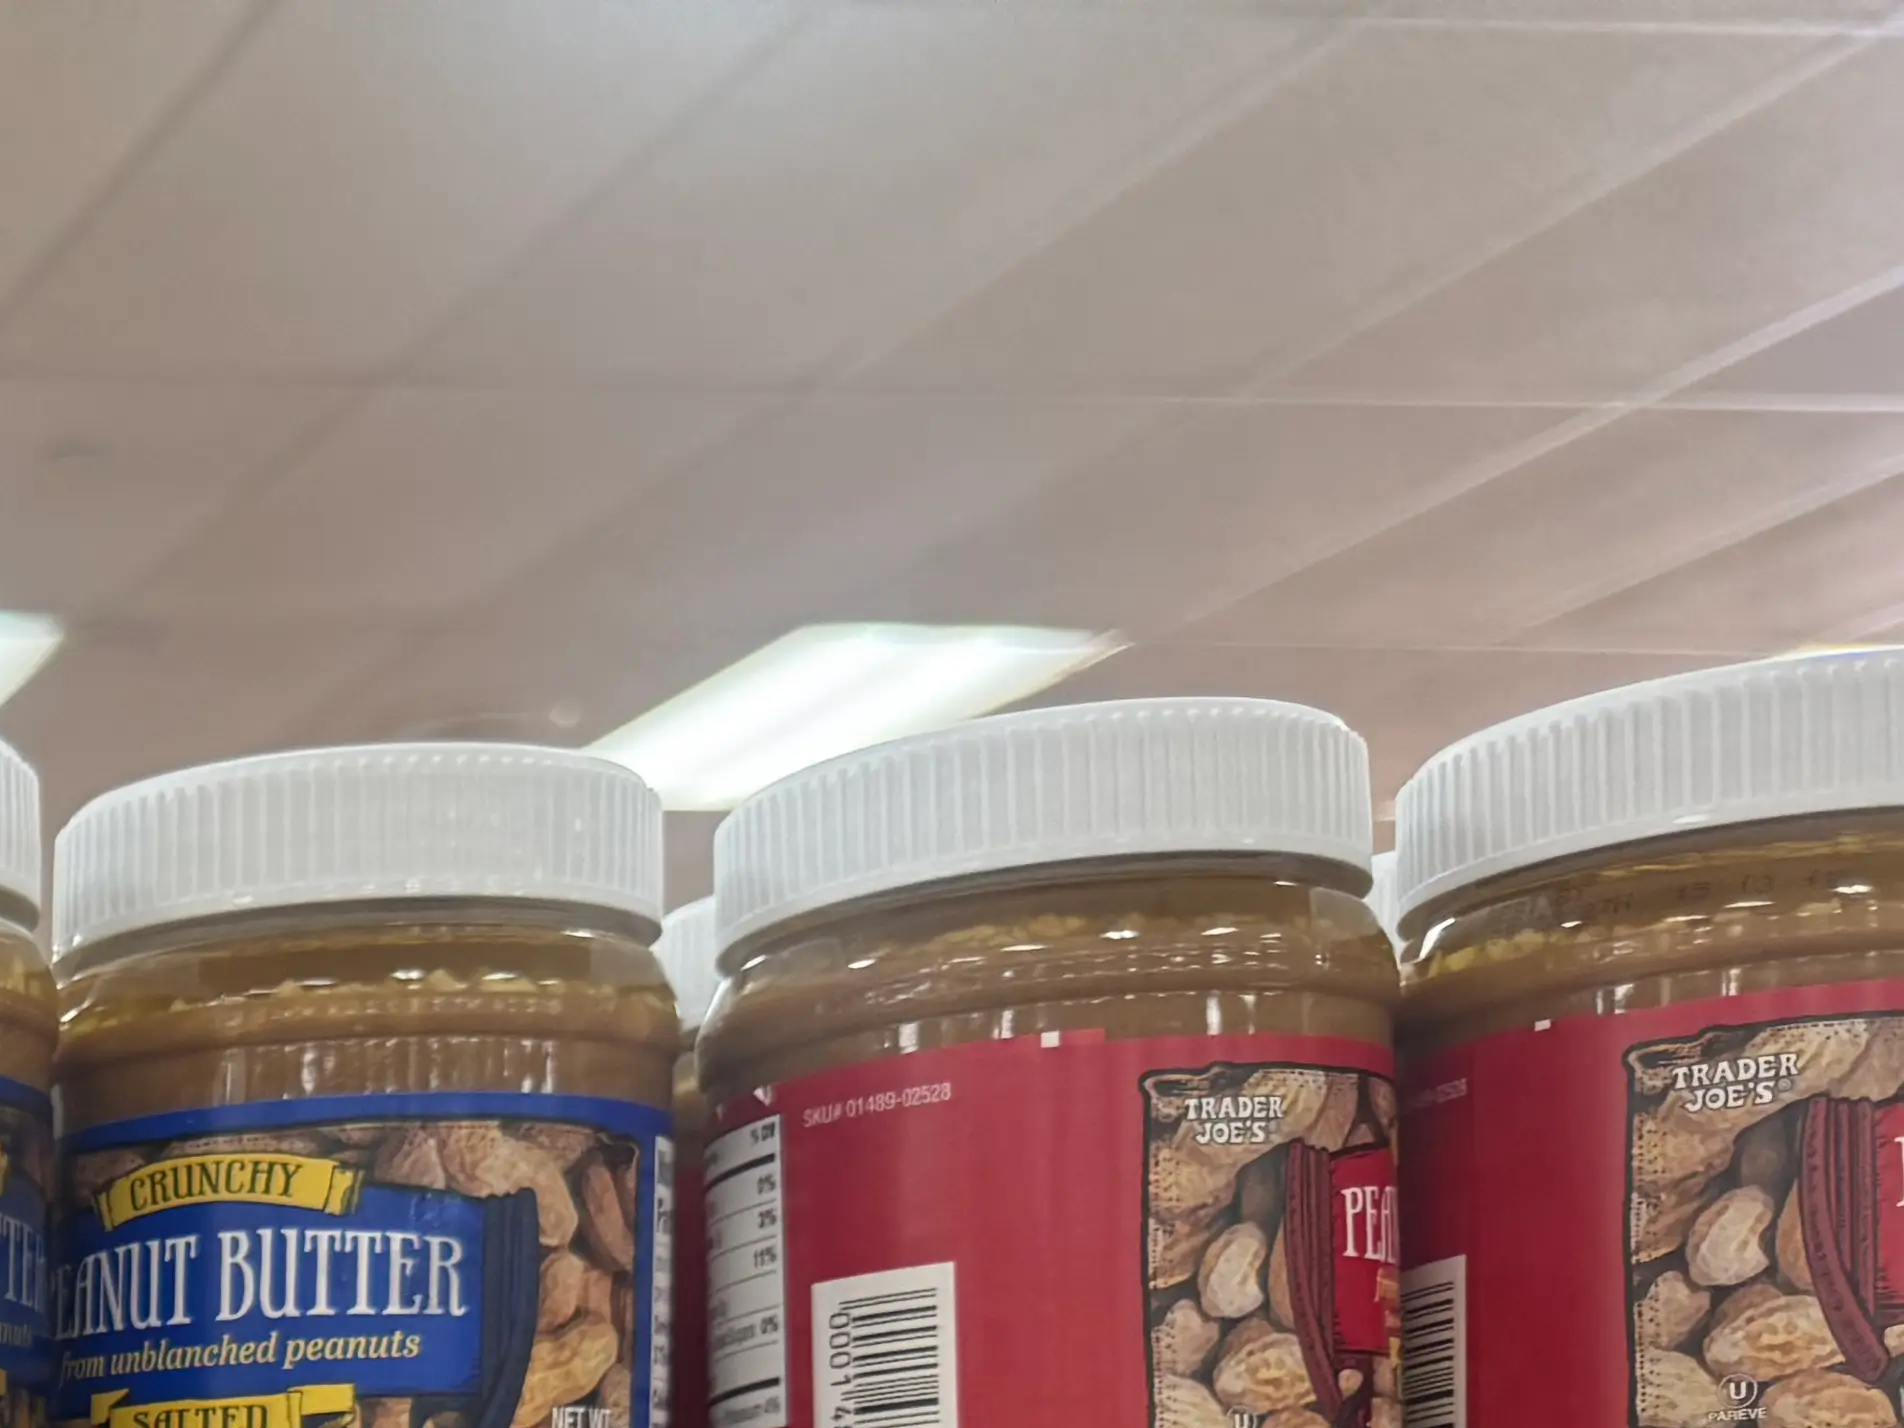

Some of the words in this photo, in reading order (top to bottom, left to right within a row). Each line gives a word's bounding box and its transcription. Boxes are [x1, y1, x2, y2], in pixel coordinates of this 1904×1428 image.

[1672, 1053, 1799, 1089] TRADER
[801, 1102, 843, 1128] SKU#
[1184, 1096, 1284, 1123] TRADER
[129, 1160, 303, 1211] CRUNCHY
[217, 1228, 467, 1318] BUTTER
[110, 1339, 276, 1372] unblanched
[284, 1332, 419, 1368] peanuts
[1708, 1406, 1767, 1422] PAREVE
